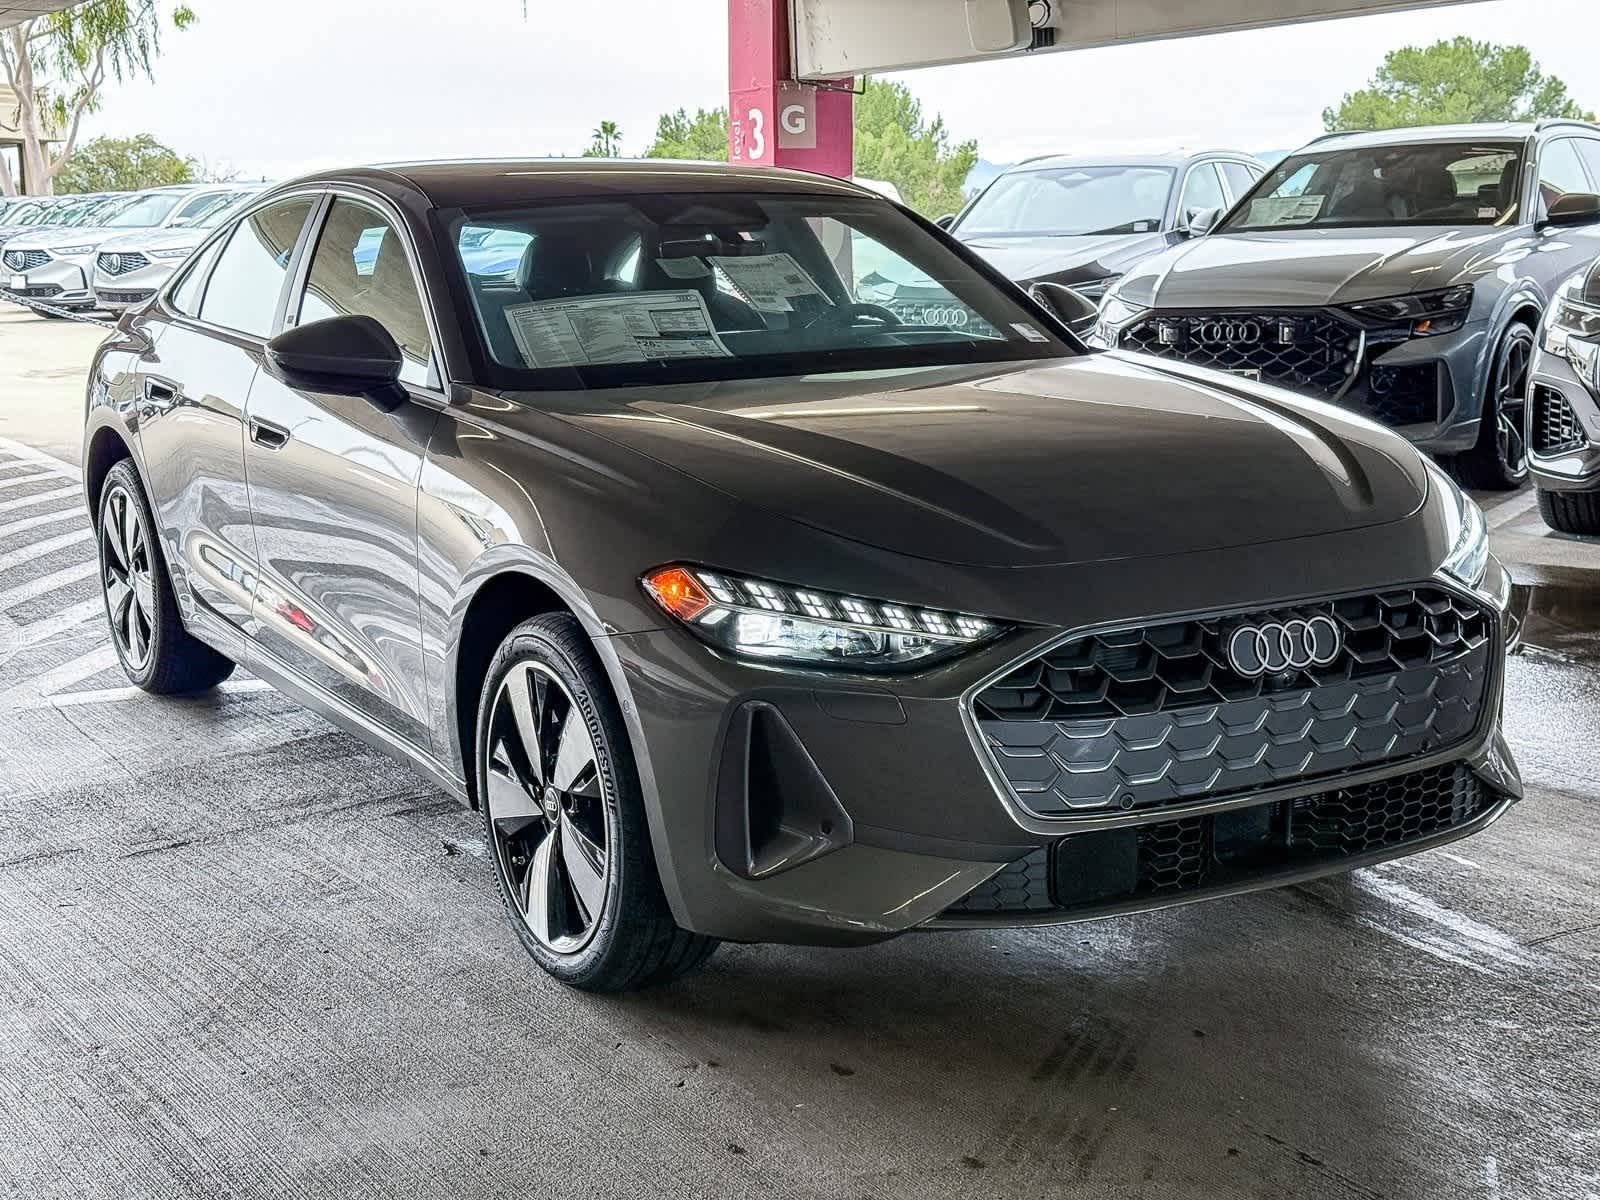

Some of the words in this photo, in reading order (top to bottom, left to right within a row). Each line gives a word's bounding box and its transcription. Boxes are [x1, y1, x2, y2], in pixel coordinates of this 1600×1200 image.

[732, 121, 741, 160] level
[749, 108, 764, 160] 3
[781, 105, 805, 134] G
[577, 689, 616, 817] BRIDGESTONE
